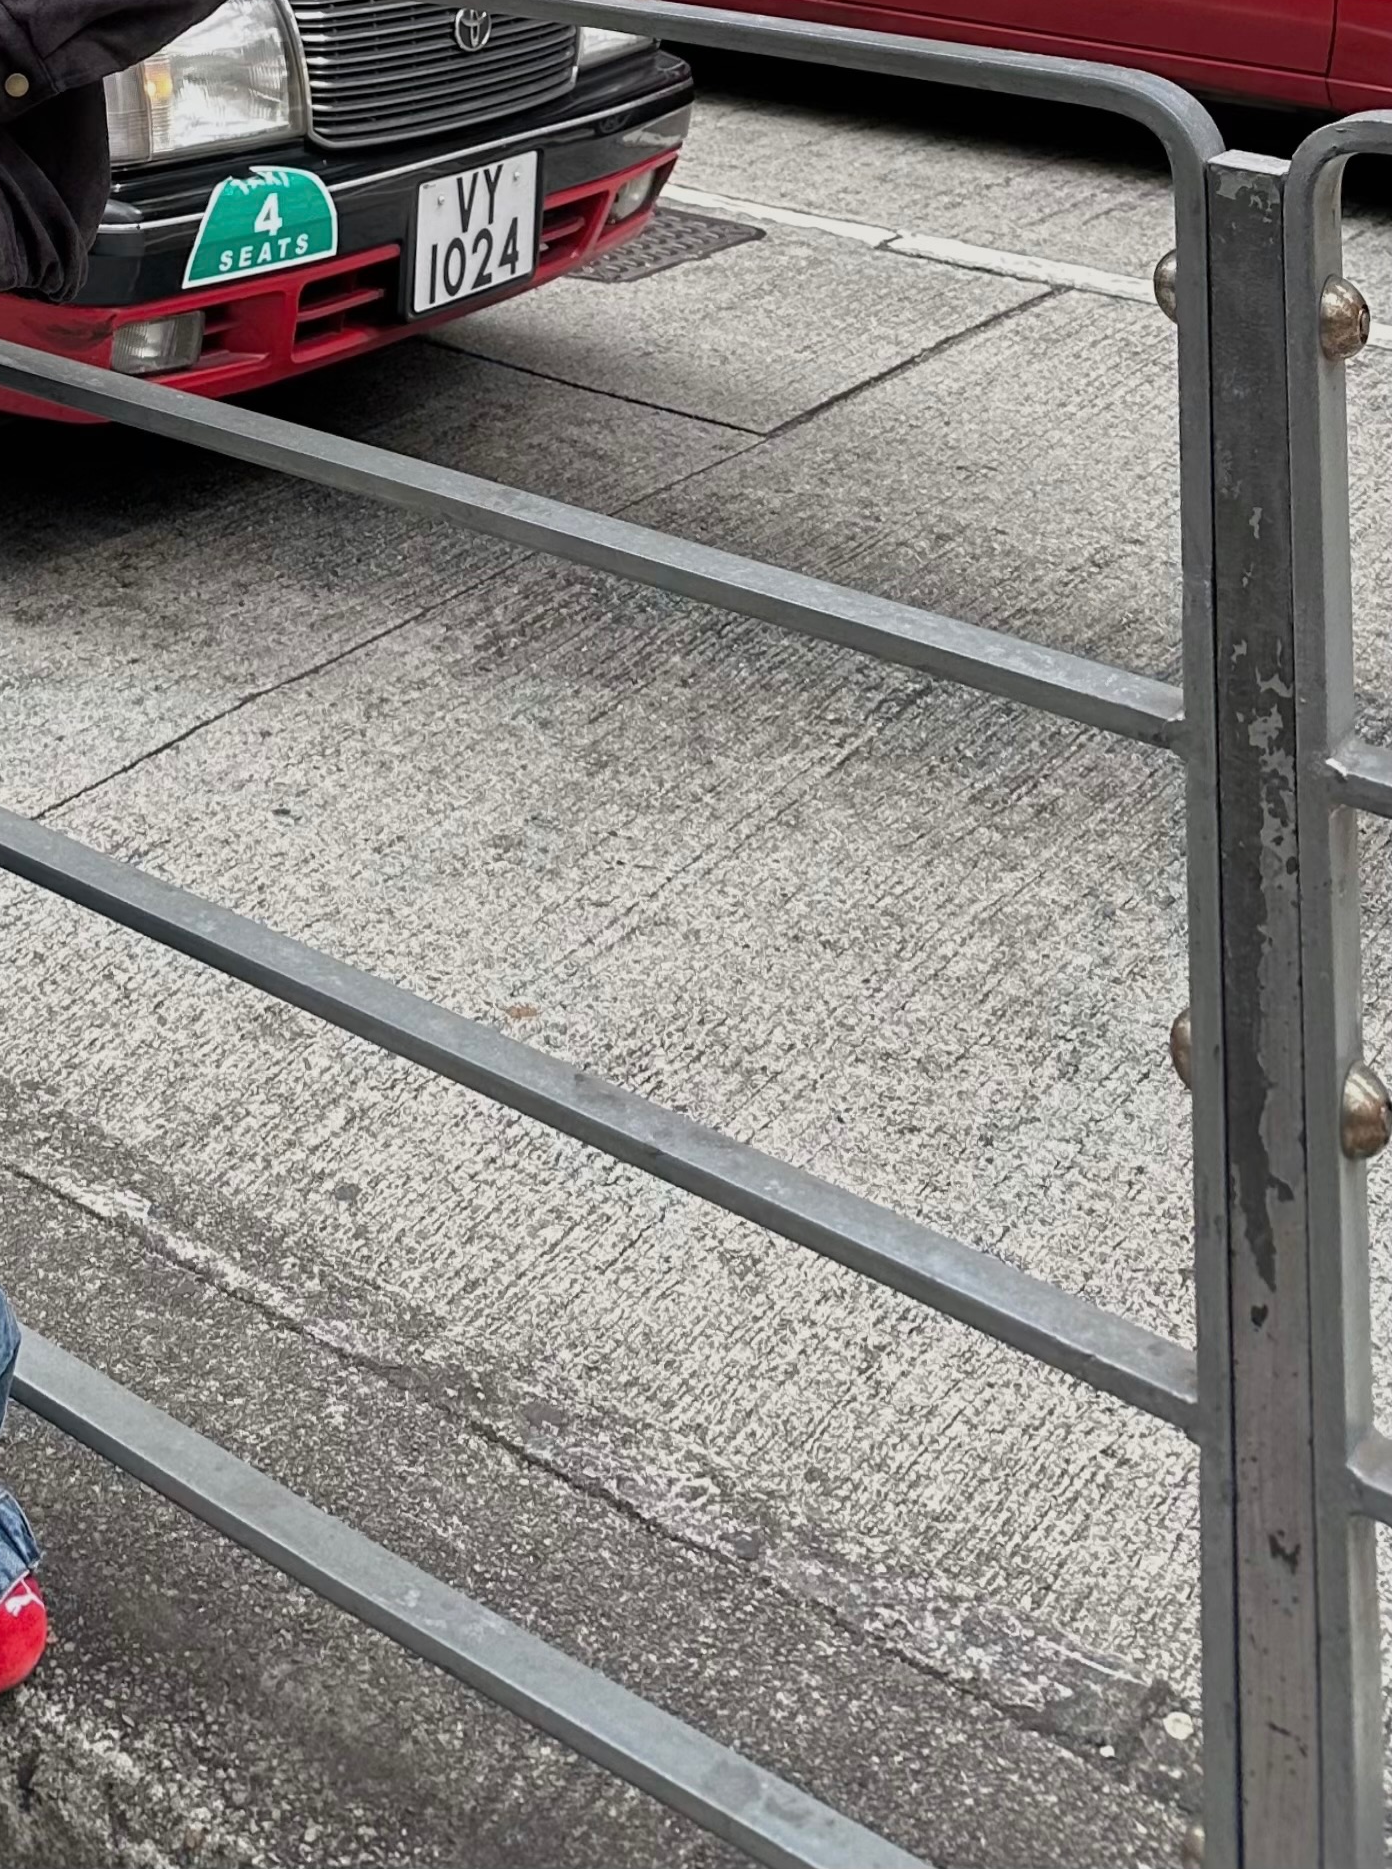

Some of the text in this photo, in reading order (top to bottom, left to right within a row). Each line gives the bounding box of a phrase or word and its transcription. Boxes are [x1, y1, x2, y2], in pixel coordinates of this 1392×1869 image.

[254, 192, 283, 237] 4
[456, 163, 504, 234] VY
[218, 233, 309, 272] SEATS
[429, 216, 519, 305] 1024
